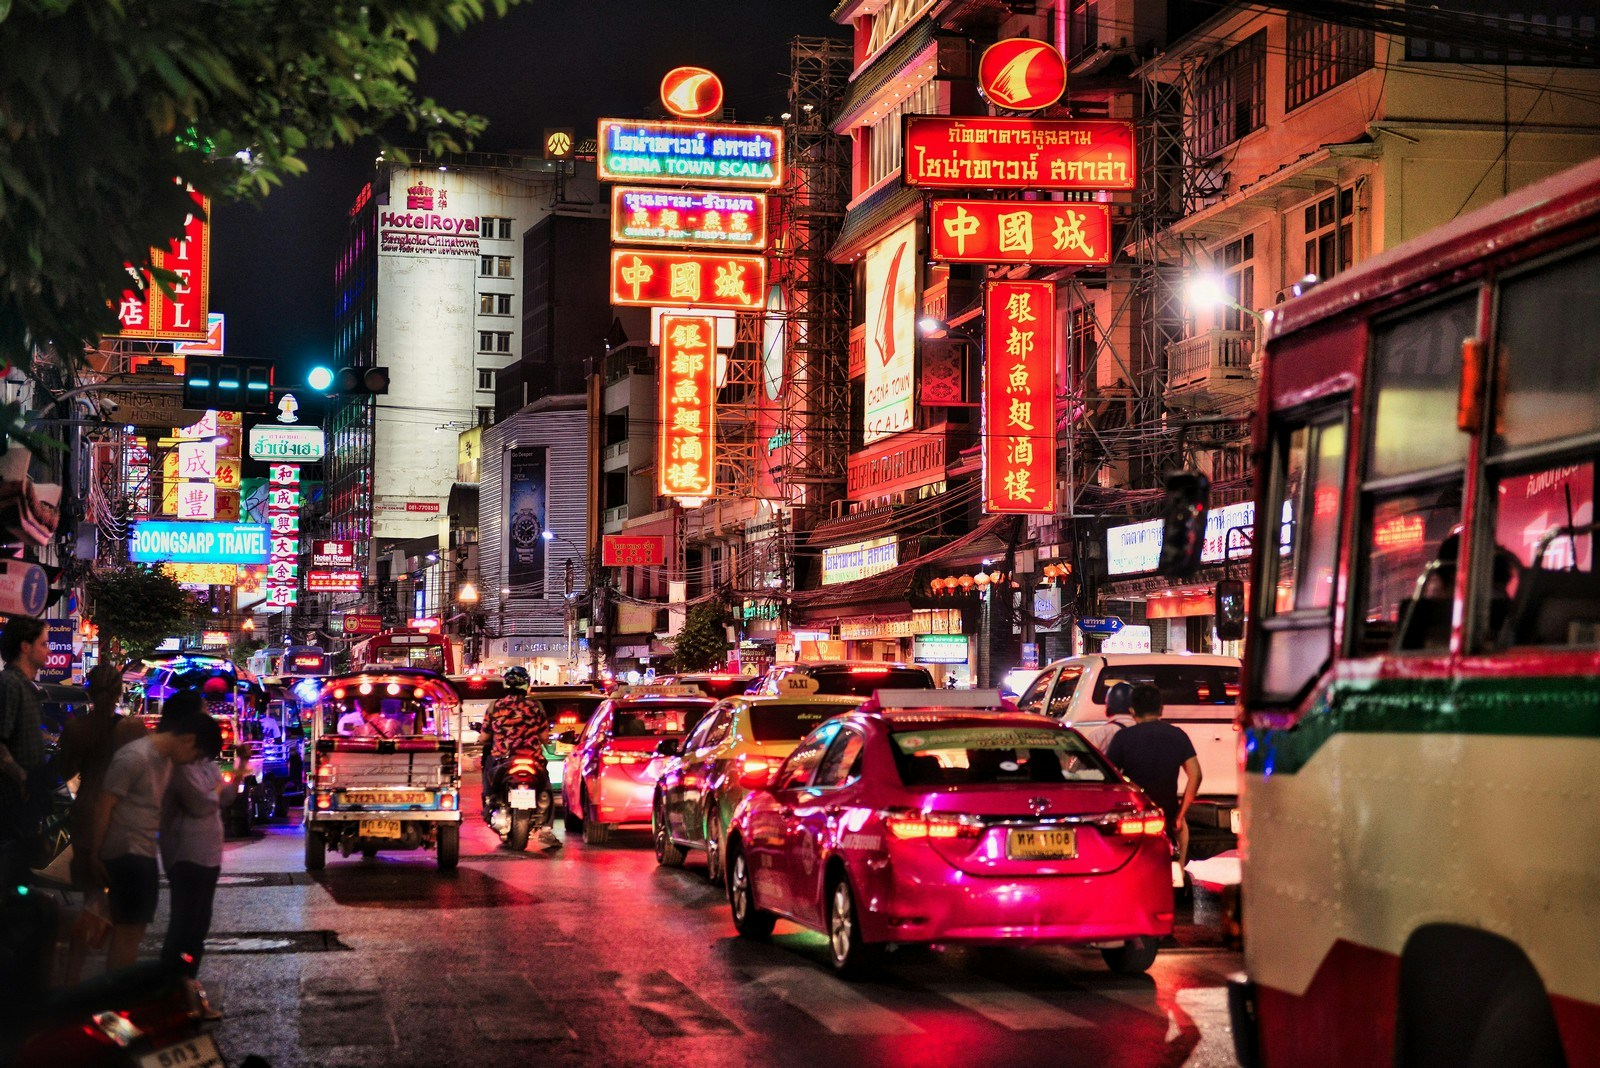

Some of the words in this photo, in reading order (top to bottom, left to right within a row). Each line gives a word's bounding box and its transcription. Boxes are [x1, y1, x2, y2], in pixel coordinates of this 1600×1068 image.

[609, 157, 661, 173] CHINA
[666, 159, 715, 176] TOWN
[718, 161, 773, 178] SCALA
[914, 146, 1039, 180] ไชน่าทาวน์
[1051, 153, 1126, 181] สกาล่า
[625, 227, 665, 237] SHARK'S
[728, 232, 752, 241] NEST
[943, 206, 1094, 257] 中國城
[621, 256, 750, 304] 中國城
[668, 324, 707, 490] 銀都魚翅酒樓
[1004, 292, 1037, 504] 銀都魚翅酒樓
[131, 409, 177, 421] HOTEL
[868, 409, 909, 439] SCALA
[132, 530, 214, 554] ROONGSARP
[218, 532, 267, 554] TRAVEL
[273, 467, 292, 603] 和成興大金行
[332, 555, 352, 563] Royal
[1112, 620, 1118, 628] 2
[788, 679, 808, 689] TAXI
[344, 793, 427, 803] THAILAND
[1043, 833, 1070, 845] 1108
